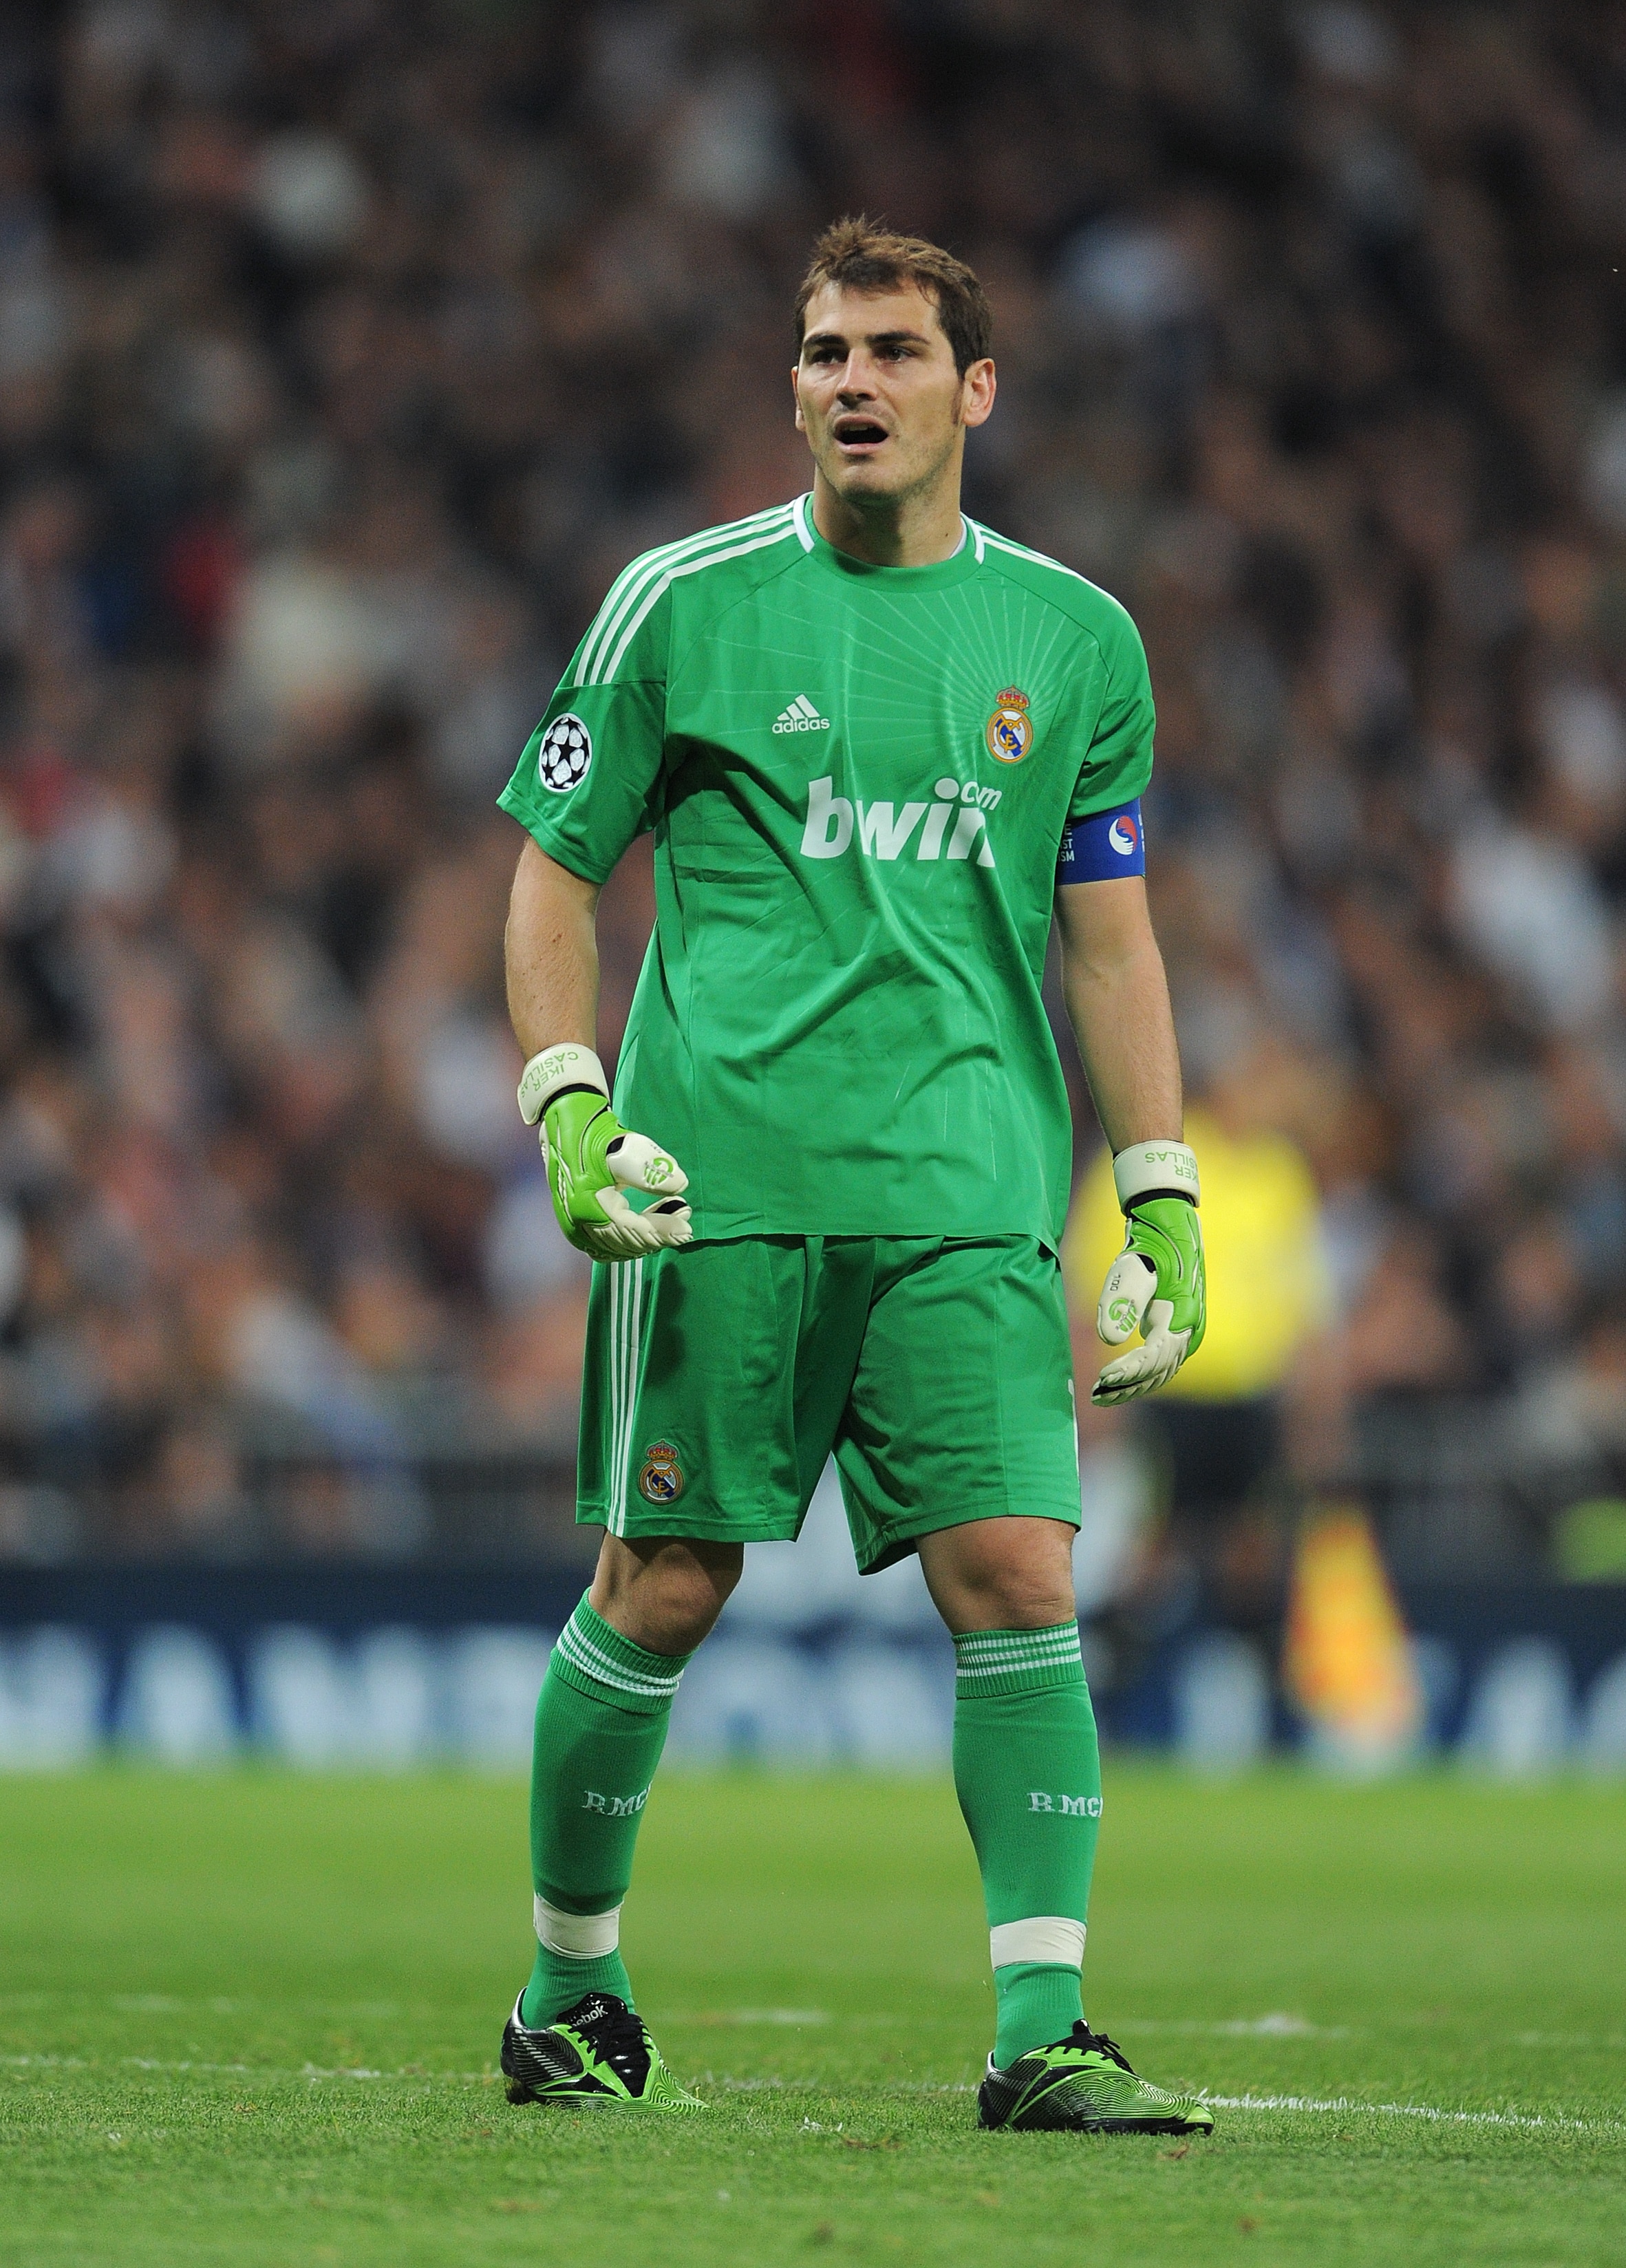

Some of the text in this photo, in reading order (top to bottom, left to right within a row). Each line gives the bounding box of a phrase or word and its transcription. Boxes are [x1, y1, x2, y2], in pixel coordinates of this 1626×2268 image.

[771, 716, 831, 735] adidas
[800, 775, 996, 868] bwin
[532, 1063, 566, 1092] IKER
[1027, 1792, 1103, 1817] RMC
